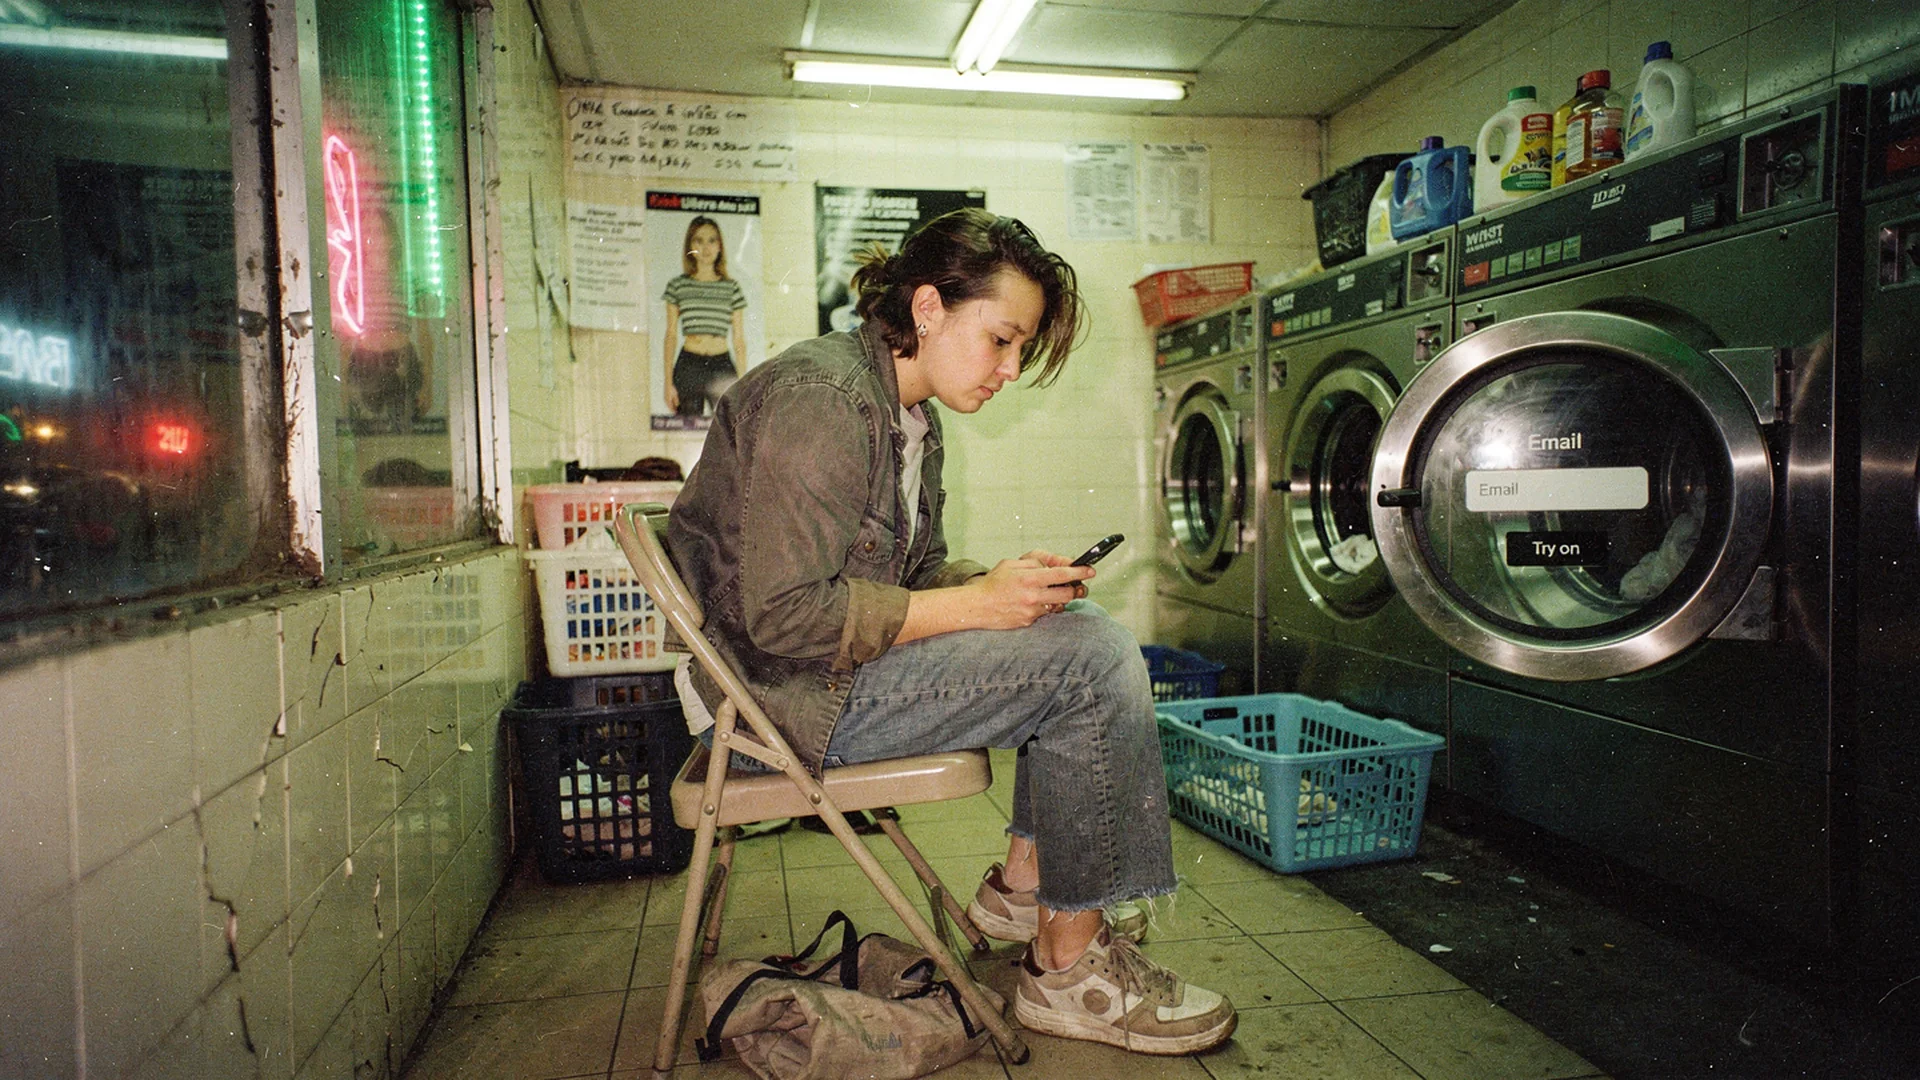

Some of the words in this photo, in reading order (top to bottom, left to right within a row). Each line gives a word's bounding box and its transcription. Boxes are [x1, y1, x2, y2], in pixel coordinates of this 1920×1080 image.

[1528, 433, 1583, 451] Email
[1479, 482, 1519, 497] Email
[1532, 541, 1556, 558] Try
[1559, 543, 1581, 555] on
